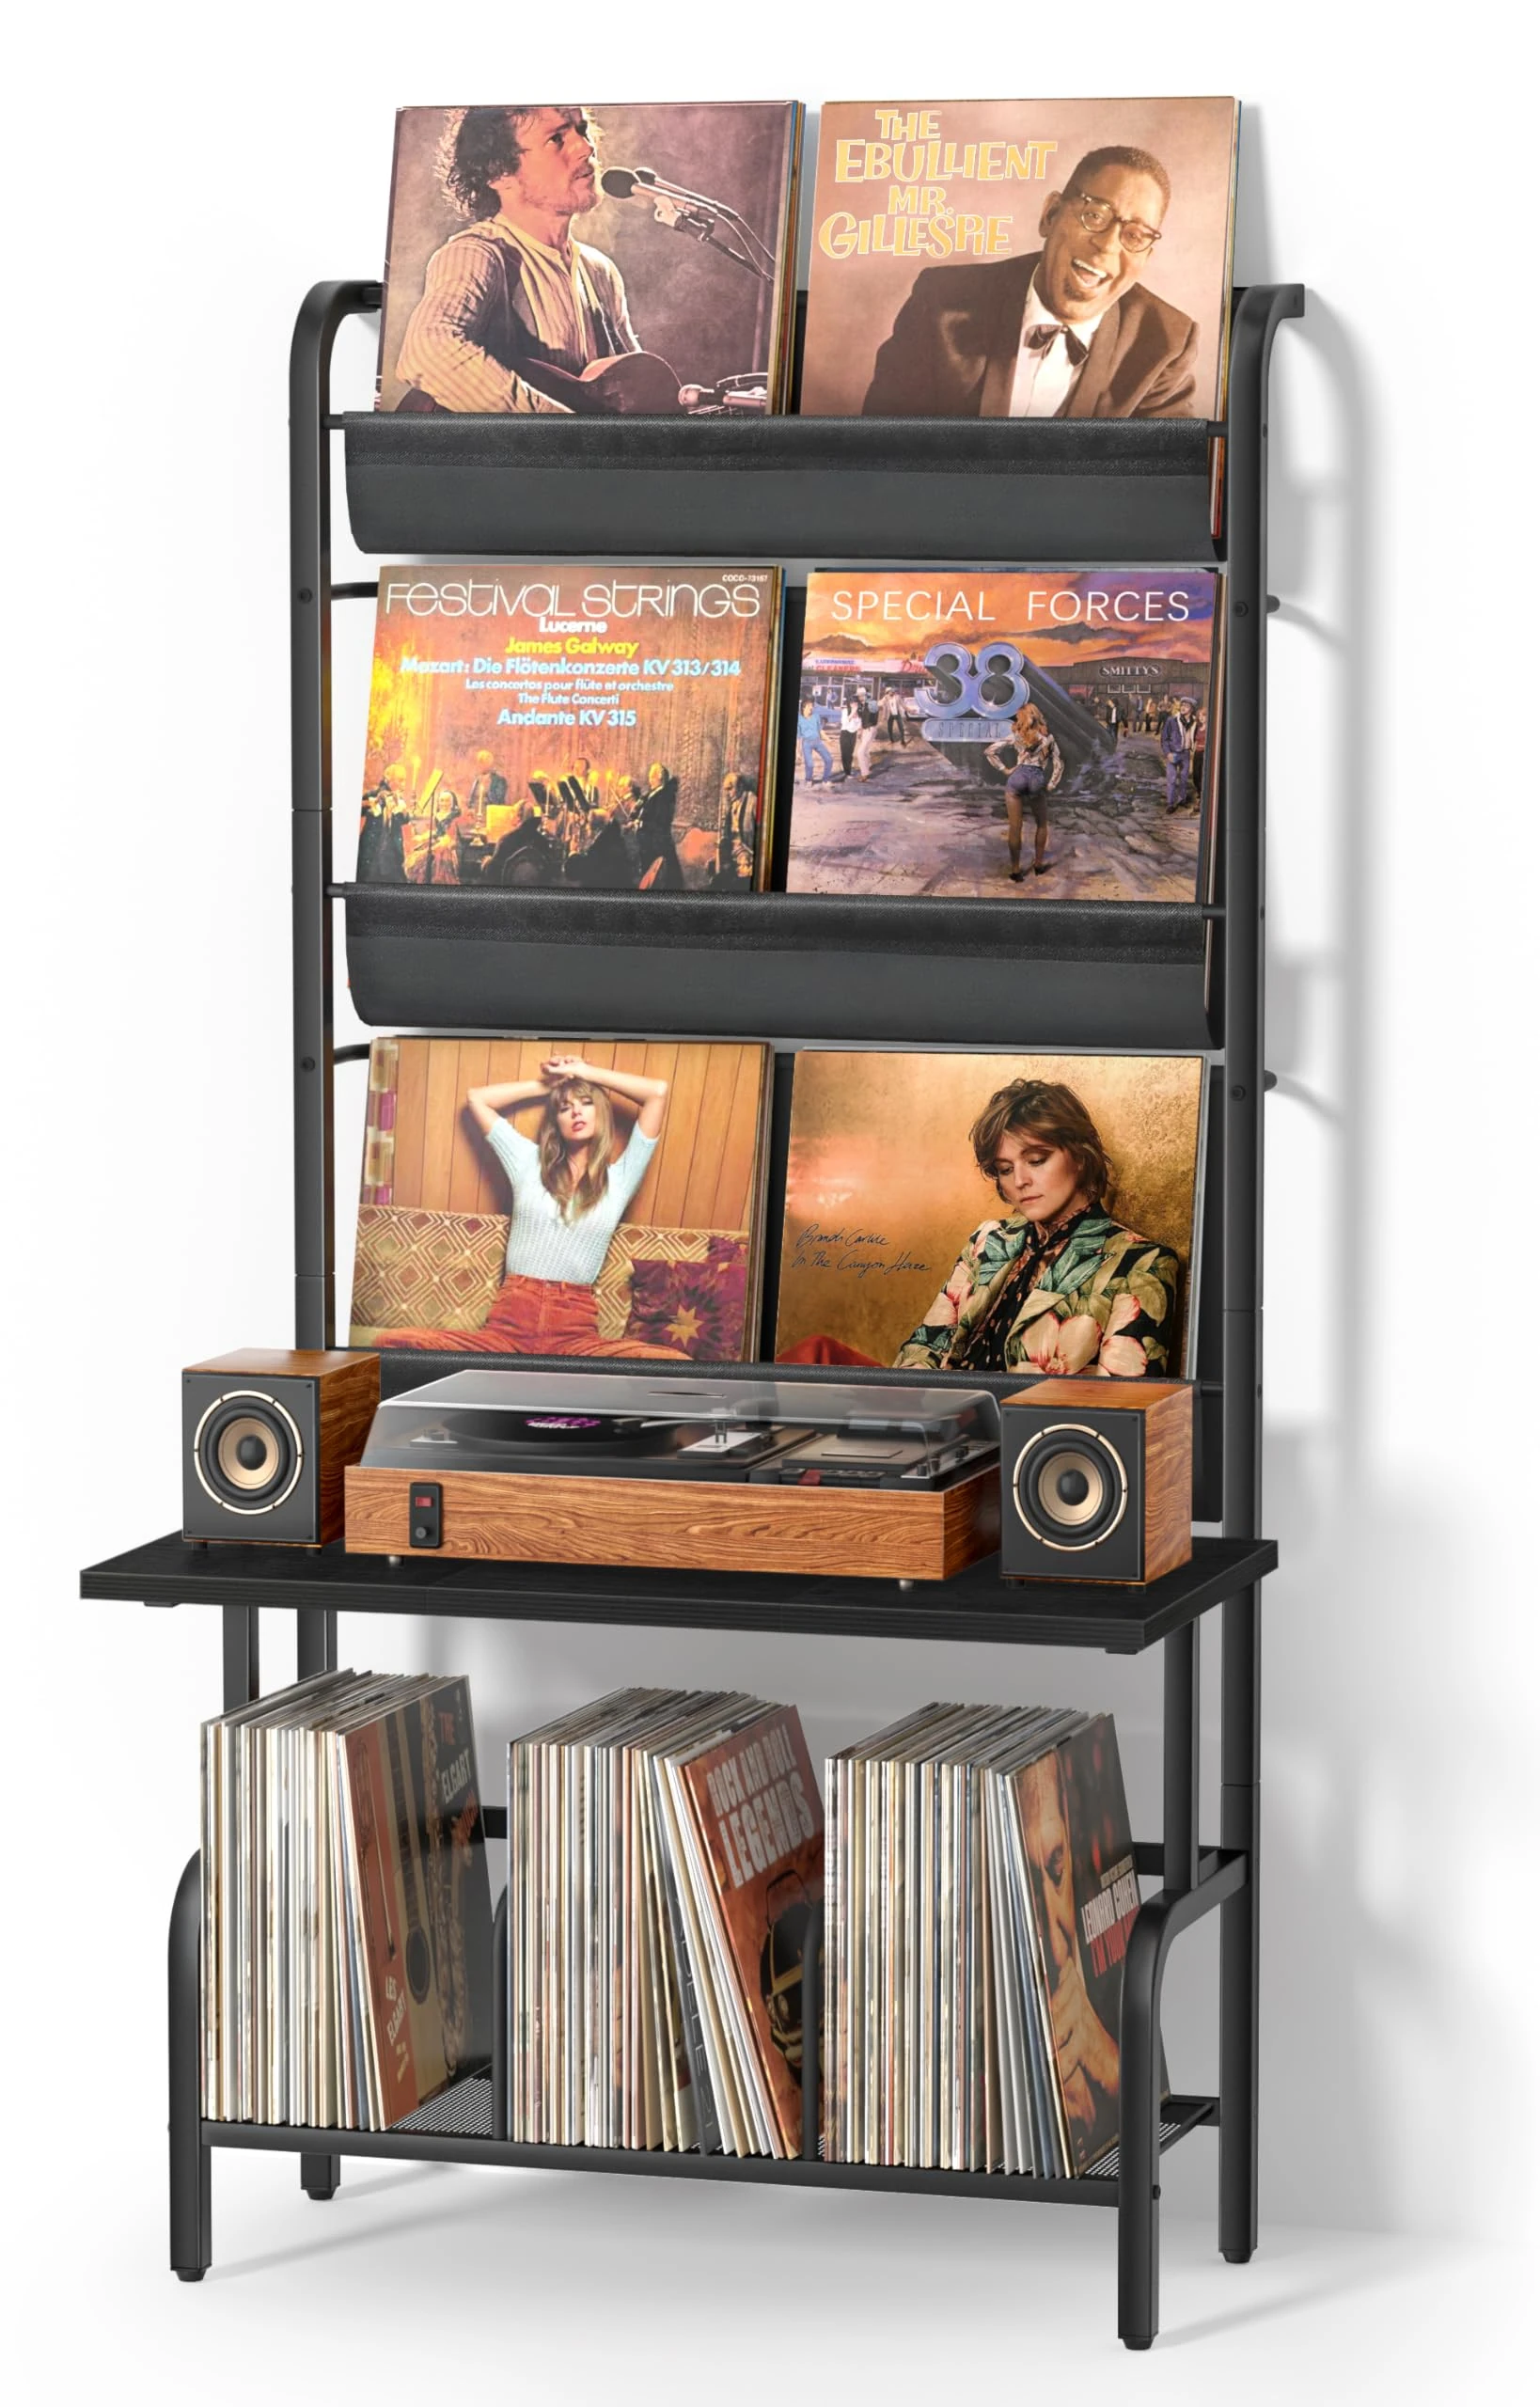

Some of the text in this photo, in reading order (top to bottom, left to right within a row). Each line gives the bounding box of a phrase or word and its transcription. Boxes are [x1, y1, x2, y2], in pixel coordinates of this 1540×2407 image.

[875, 109, 942, 141] THE
[835, 139, 1058, 182] EBULLIENT
[888, 185, 954, 215] MR.
[819, 212, 1014, 260] GILLESPIE
[831, 590, 1189, 621] SPECIAL FORCES
[539, 617, 607, 634] Lucerne
[505, 636, 639, 659] James Galway
[473, 657, 502, 674] Die
[506, 656, 639, 675] Flötenkonzerte
[643, 659, 671, 676] KV
[671, 659, 741, 677] 313/314
[914, 641, 1030, 720] 38
[519, 693, 539, 703] The
[571, 694, 620, 705] Concerti
[542, 681, 574, 694] pour
[618, 680, 674, 692] orchestre
[497, 709, 637, 727] Andante KV 315
[937, 721, 1002, 739] SPECIAL
[706, 1756, 746, 1817] ROCK
[762, 1723, 798, 1780] ROLL
[718, 1770, 815, 1889] LEGENDS
